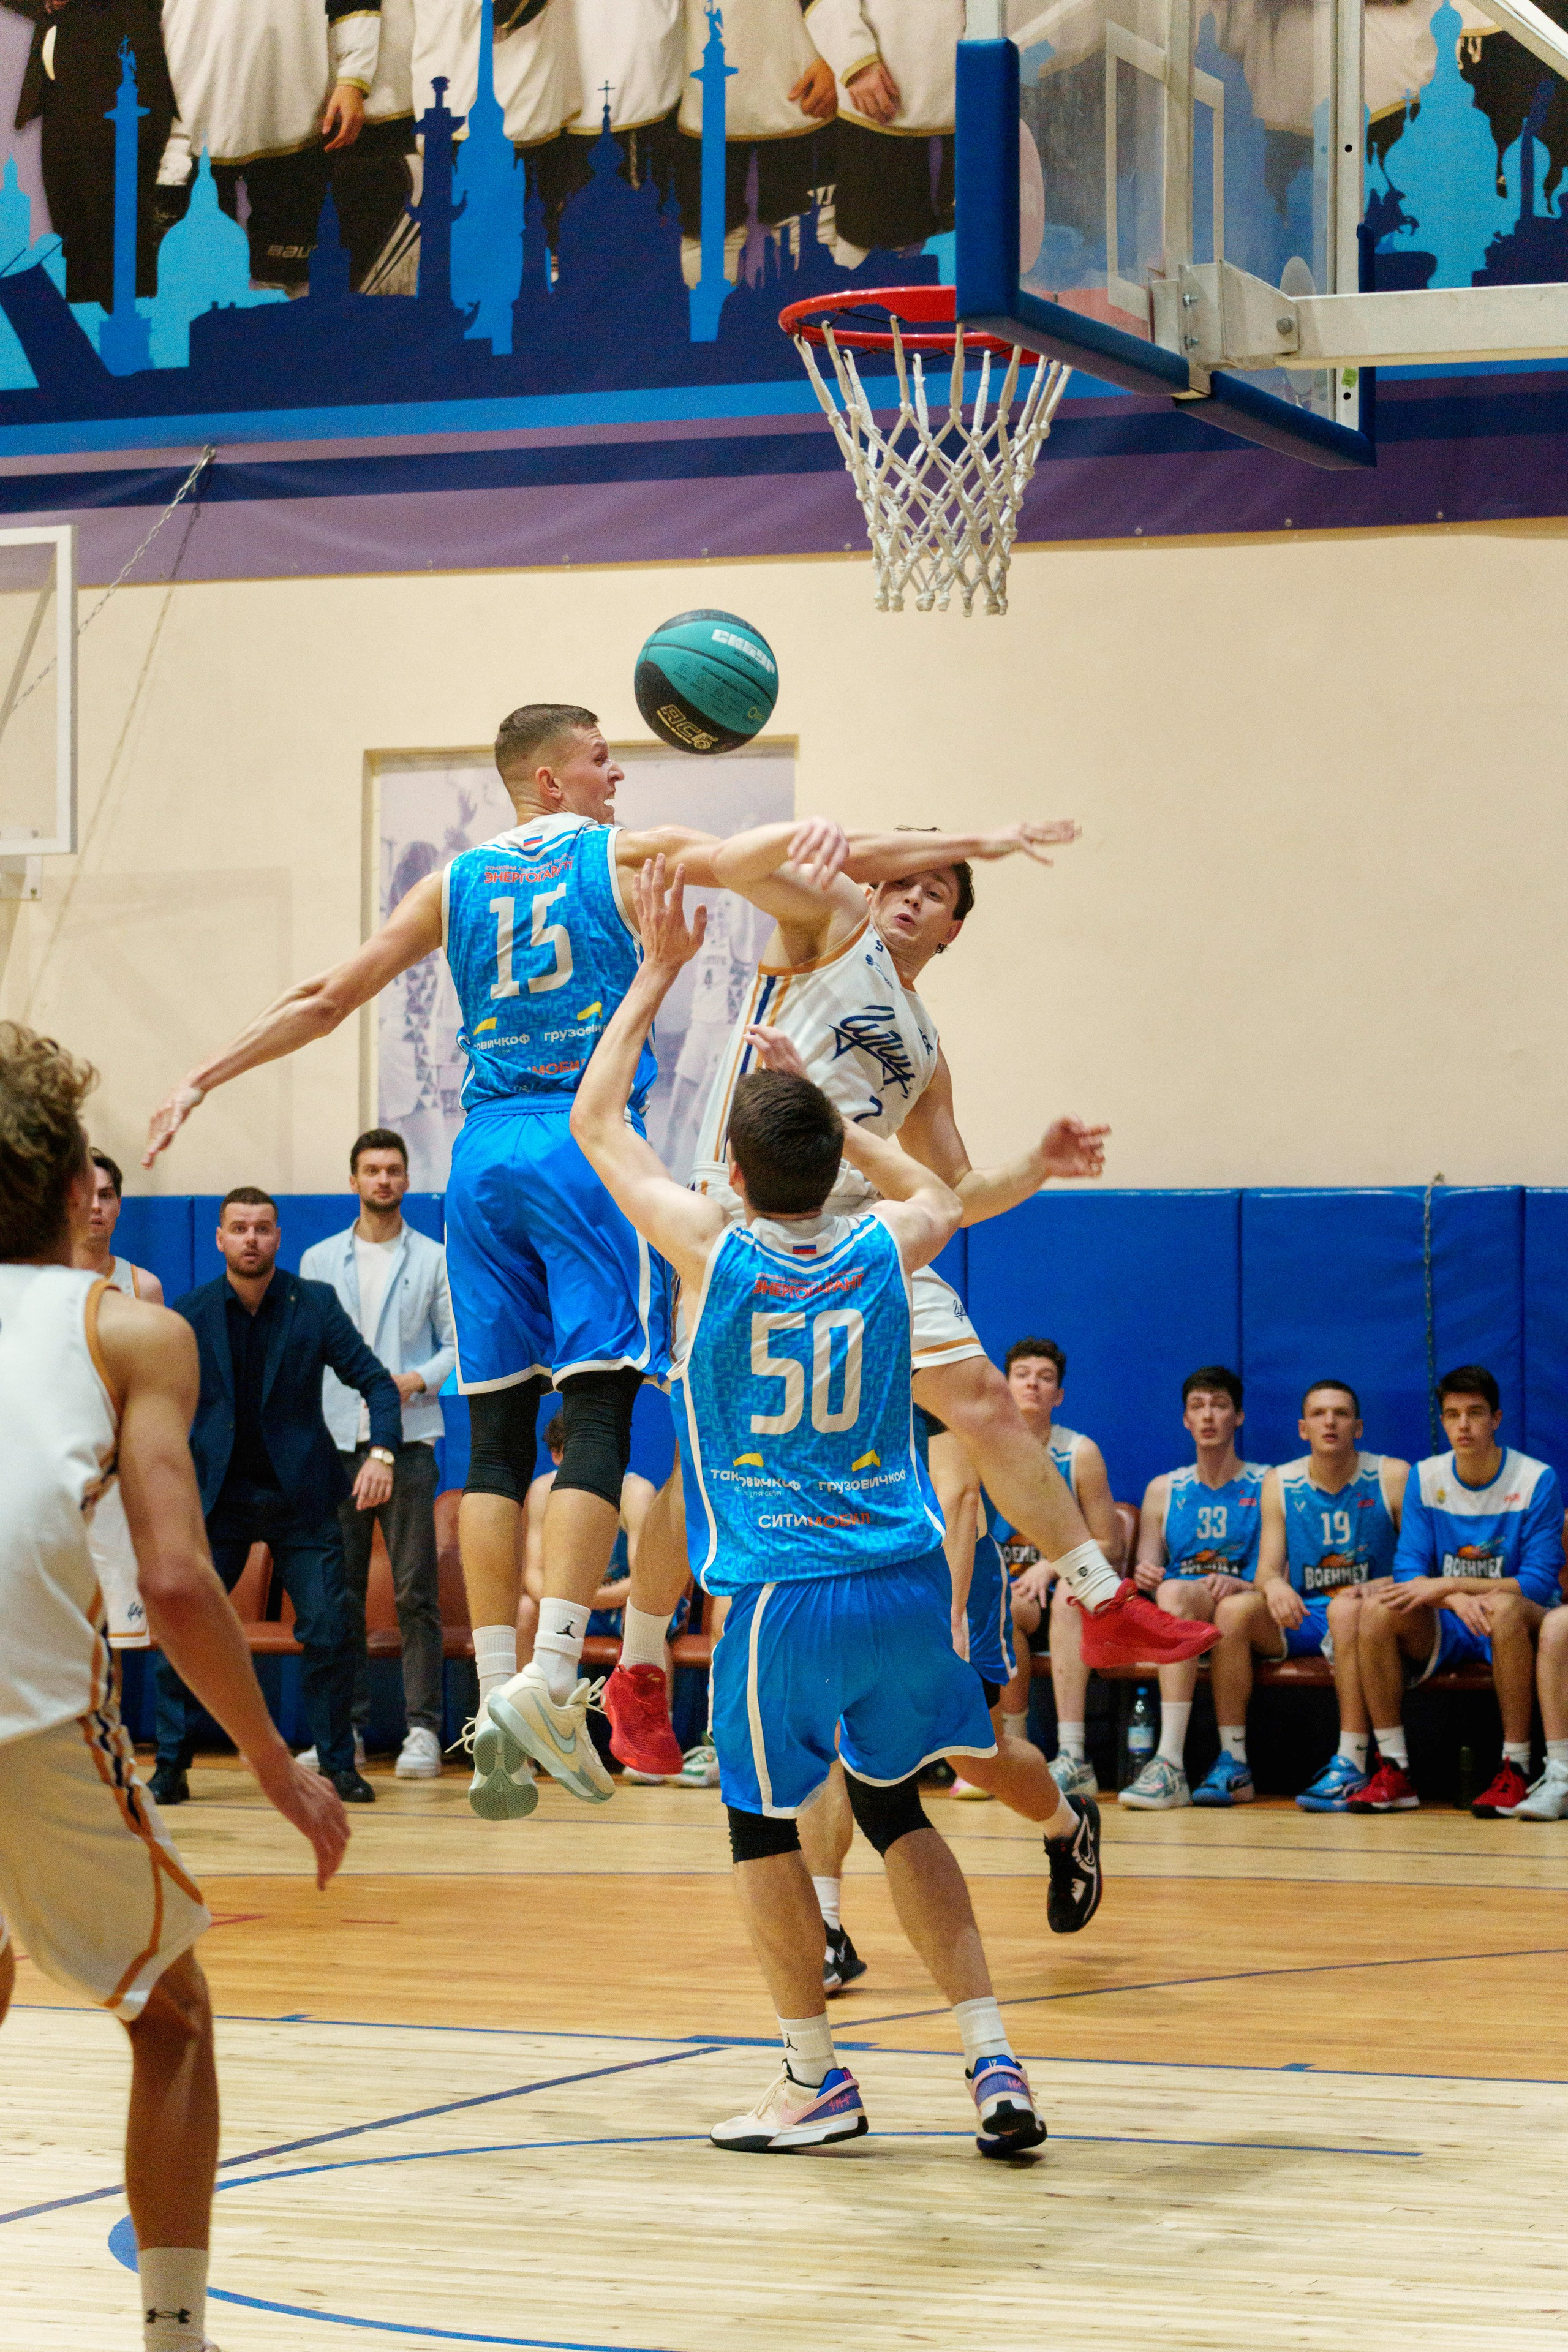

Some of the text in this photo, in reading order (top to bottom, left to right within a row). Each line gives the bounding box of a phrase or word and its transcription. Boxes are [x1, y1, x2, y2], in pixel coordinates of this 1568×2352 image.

[490, 882, 573, 1000] 15
[473, 1033, 530, 1051] овичкоф
[527, 1058, 586, 1076] МОБИ
[750, 1308, 864, 1435] 50
[758, 1512, 870, 1529] СИТИМОБИЛ
[1196, 1506, 1228, 1540] 33
[1321, 1510, 1351, 1547] 19
